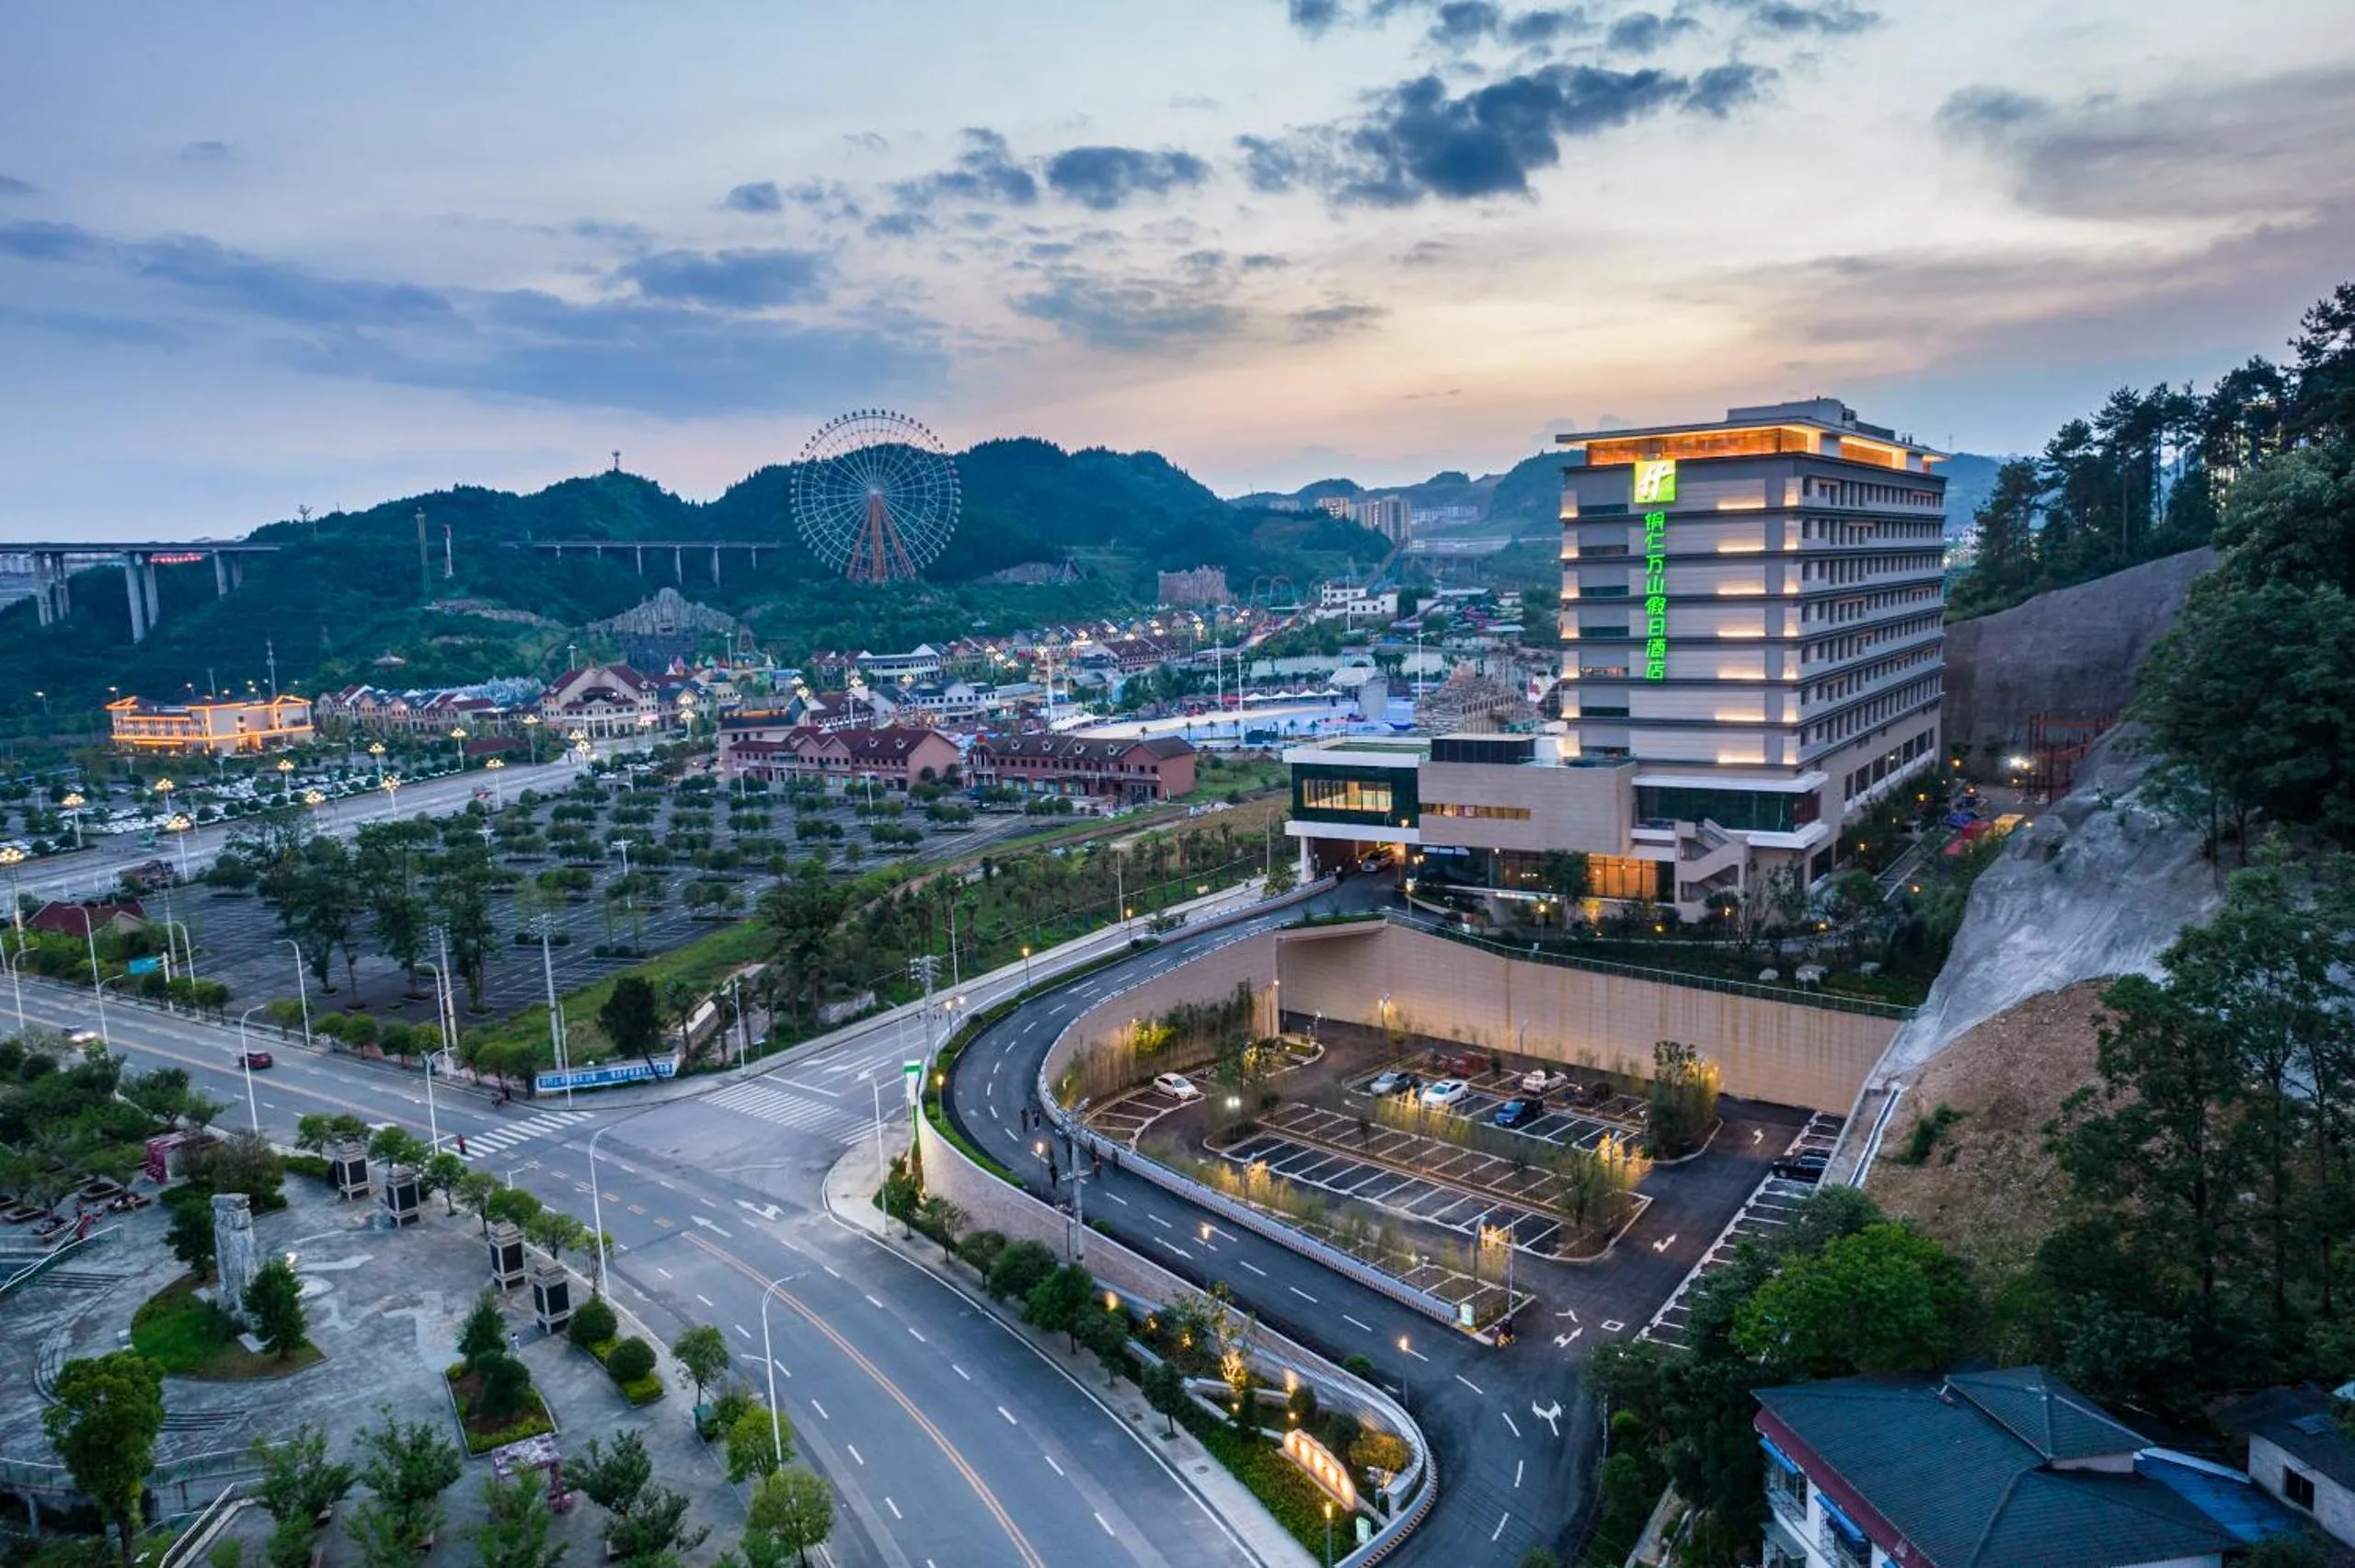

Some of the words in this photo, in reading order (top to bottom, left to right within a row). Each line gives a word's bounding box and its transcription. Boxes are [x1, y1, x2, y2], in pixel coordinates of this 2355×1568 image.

[1645, 511, 1666, 680] 铜仁万山假日酒店
